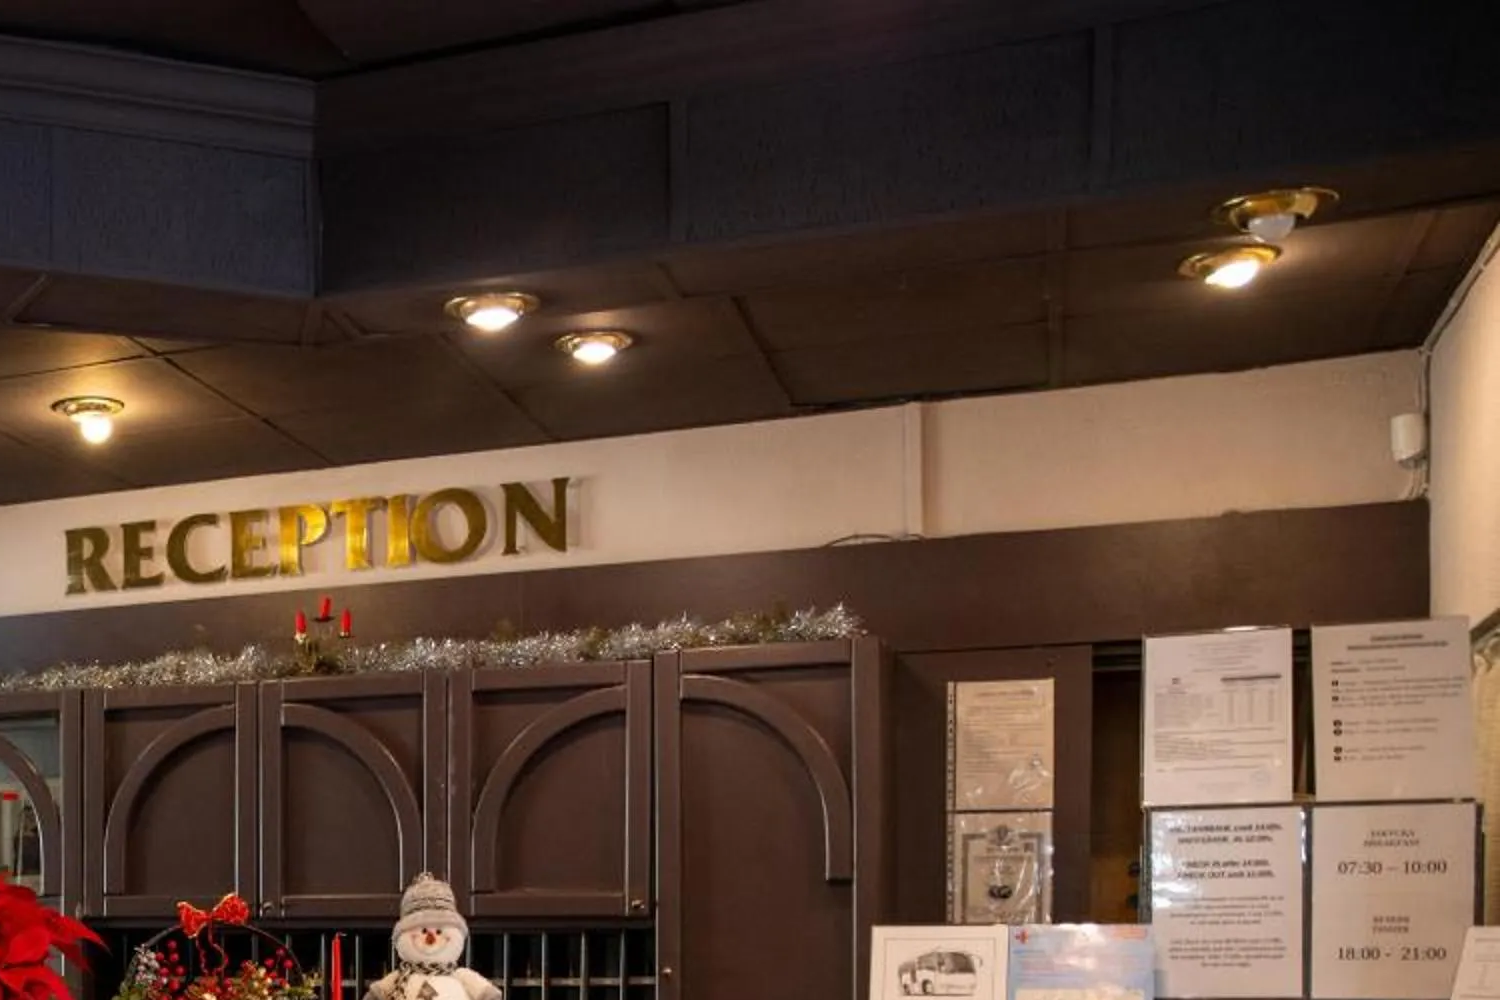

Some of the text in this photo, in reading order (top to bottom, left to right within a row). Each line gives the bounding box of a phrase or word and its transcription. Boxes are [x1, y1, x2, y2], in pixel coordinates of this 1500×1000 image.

[64, 477, 570, 595] RECEPTION
[1337, 861, 1383, 875] 07:30
[1403, 860, 1448, 875] 10:00
[1337, 947, 1381, 961] 18:00
[1400, 947, 1448, 961] 21:00
